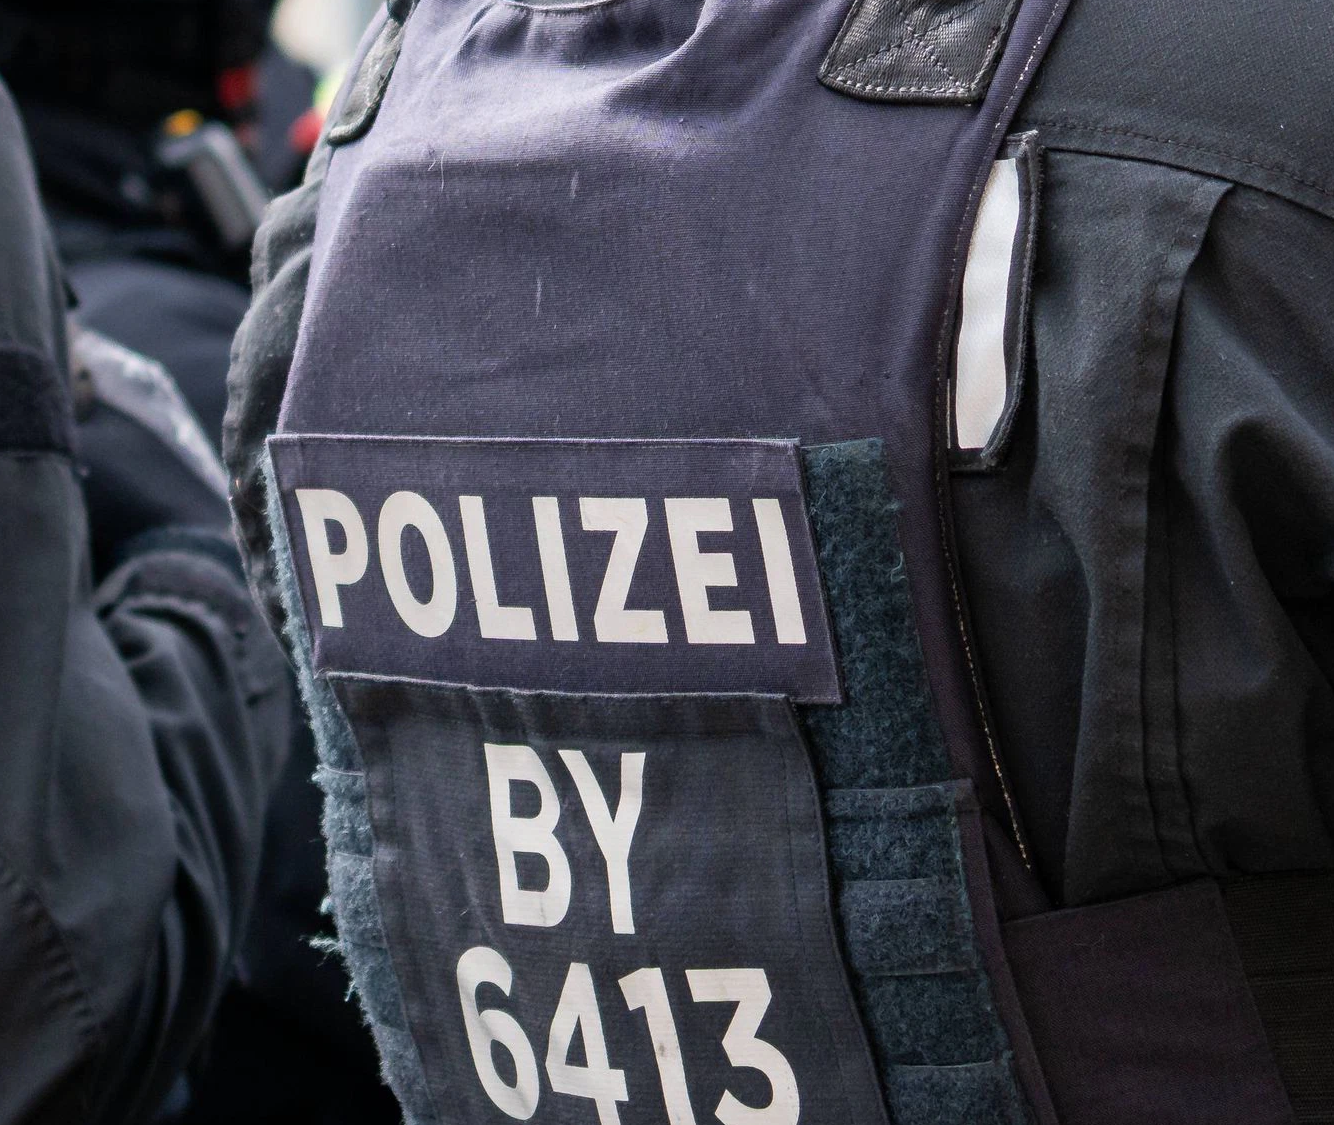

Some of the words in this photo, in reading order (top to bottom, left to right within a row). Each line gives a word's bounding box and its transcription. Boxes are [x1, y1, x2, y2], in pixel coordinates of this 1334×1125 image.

[294, 488, 808, 645] POLIZEI
[483, 742, 647, 935] BY
[456, 945, 800, 1125] 6413
